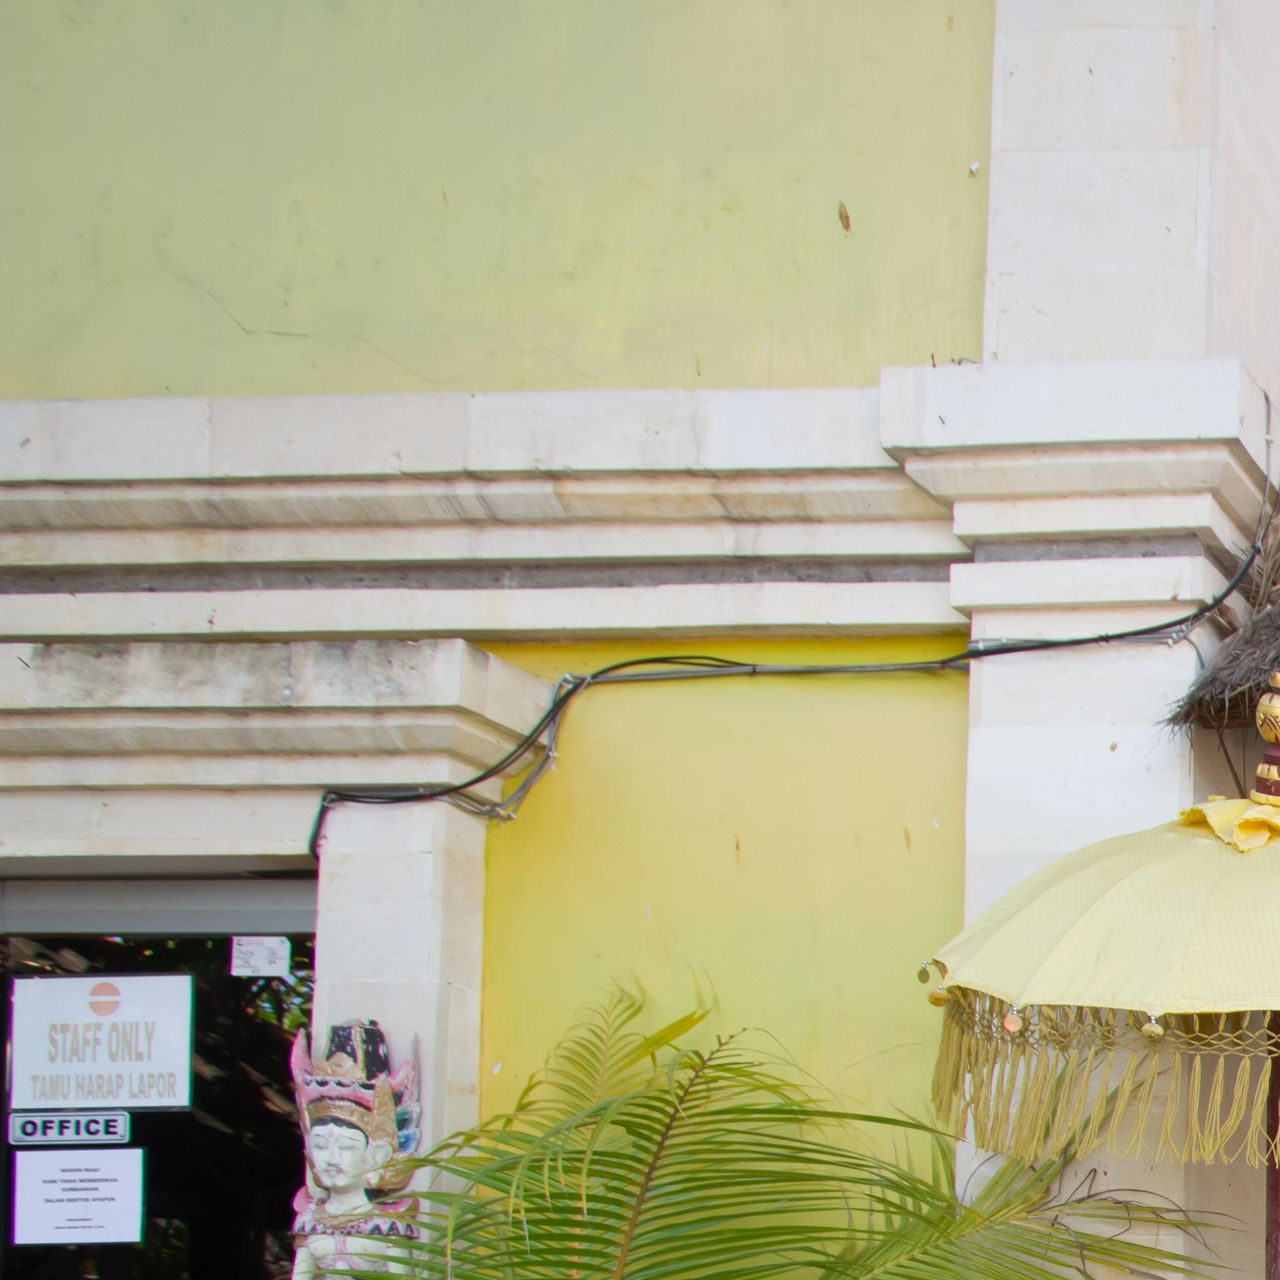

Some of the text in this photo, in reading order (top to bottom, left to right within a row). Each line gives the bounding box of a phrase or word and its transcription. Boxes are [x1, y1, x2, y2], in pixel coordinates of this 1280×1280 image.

[48, 1021, 156, 1063] STAFF ONLY
[31, 1072, 177, 1100] TAMU HARAP LAPOR
[20, 1119, 118, 1136] OFFICE
